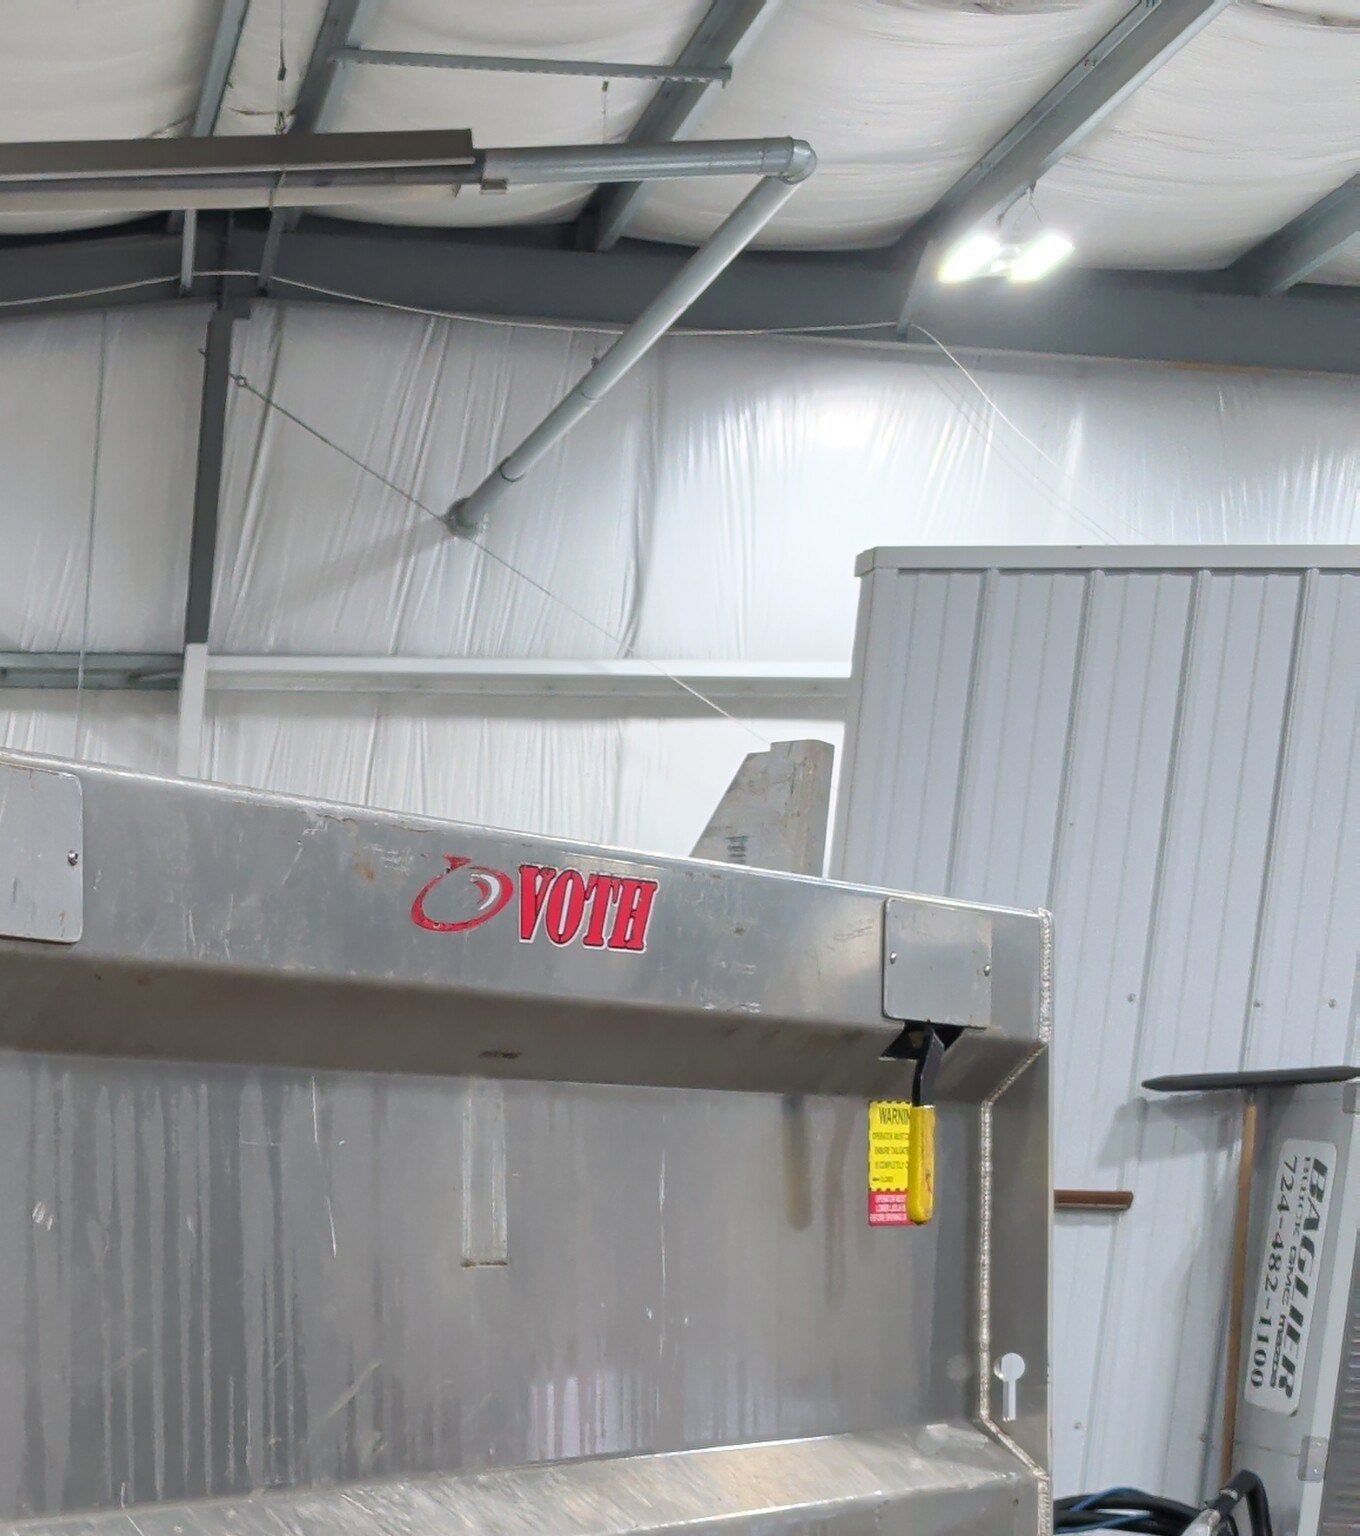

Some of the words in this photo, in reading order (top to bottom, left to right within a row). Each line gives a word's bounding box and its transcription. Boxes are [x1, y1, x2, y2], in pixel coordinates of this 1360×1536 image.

[519, 863, 659, 952] VOTH
[879, 1107, 910, 1125] WARNIN
[1293, 1157, 1311, 1236] BUICK
[1251, 1156, 1297, 1388] 724-482-1100
[1279, 1158, 1328, 1398] BAGLIER
[1282, 1246, 1297, 1305] GMC
